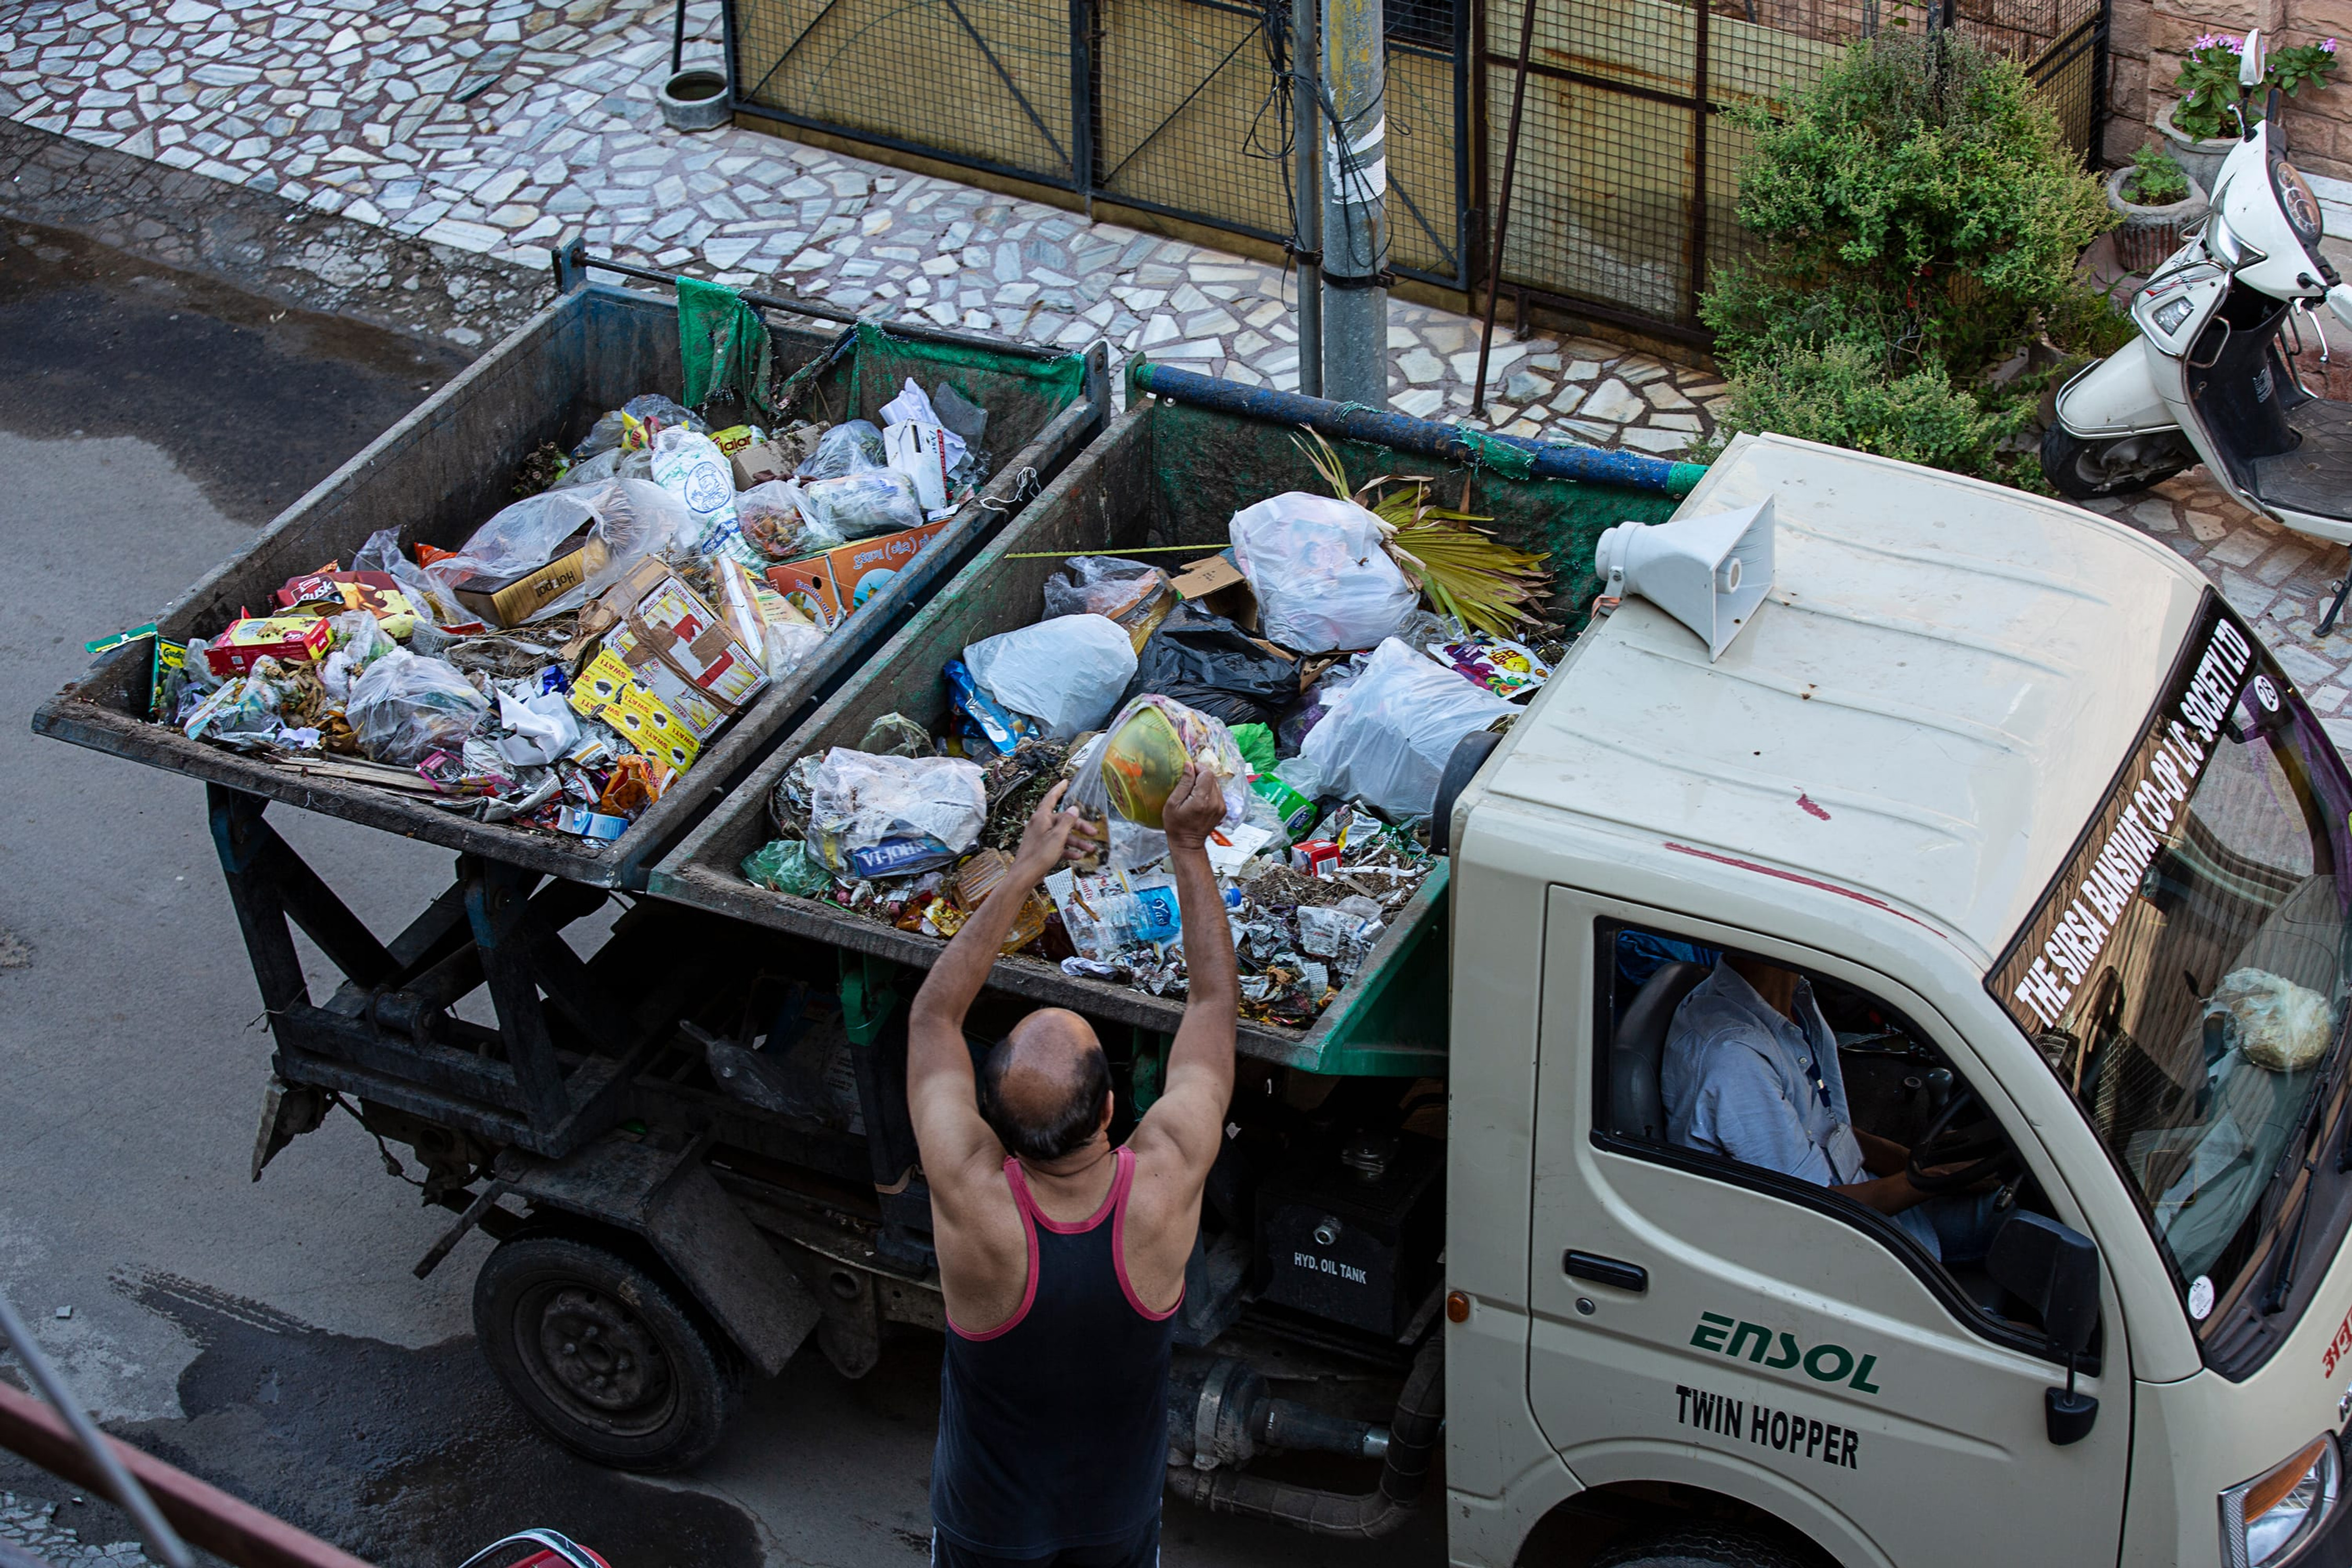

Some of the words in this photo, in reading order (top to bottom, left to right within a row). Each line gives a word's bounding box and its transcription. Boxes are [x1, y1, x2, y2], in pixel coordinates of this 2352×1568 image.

[600, 659, 627, 678] SWATI
[625, 695, 650, 713] SWATI
[2257, 678, 2277, 706] 28
[646, 730, 667, 749] SWATI
[672, 728, 695, 748] SWATI
[2014, 955, 2071, 1028] THE
[2044, 898, 2109, 986] SIRSA
[2080, 803, 2160, 926] BANSIVAT
[2134, 750, 2187, 833] CO-OP
[2180, 644, 2237, 742] SOCIETY
[2210, 618, 2252, 676] LTD
[1294, 1252, 1318, 1270] HYD.
[1321, 1259, 1338, 1275] OIL
[1340, 1263, 1366, 1285] TANK
[1689, 1311, 1880, 1394] ENSOL
[1676, 1384, 1743, 1439] TWIN
[1750, 1404, 1859, 1470] HOPPER
